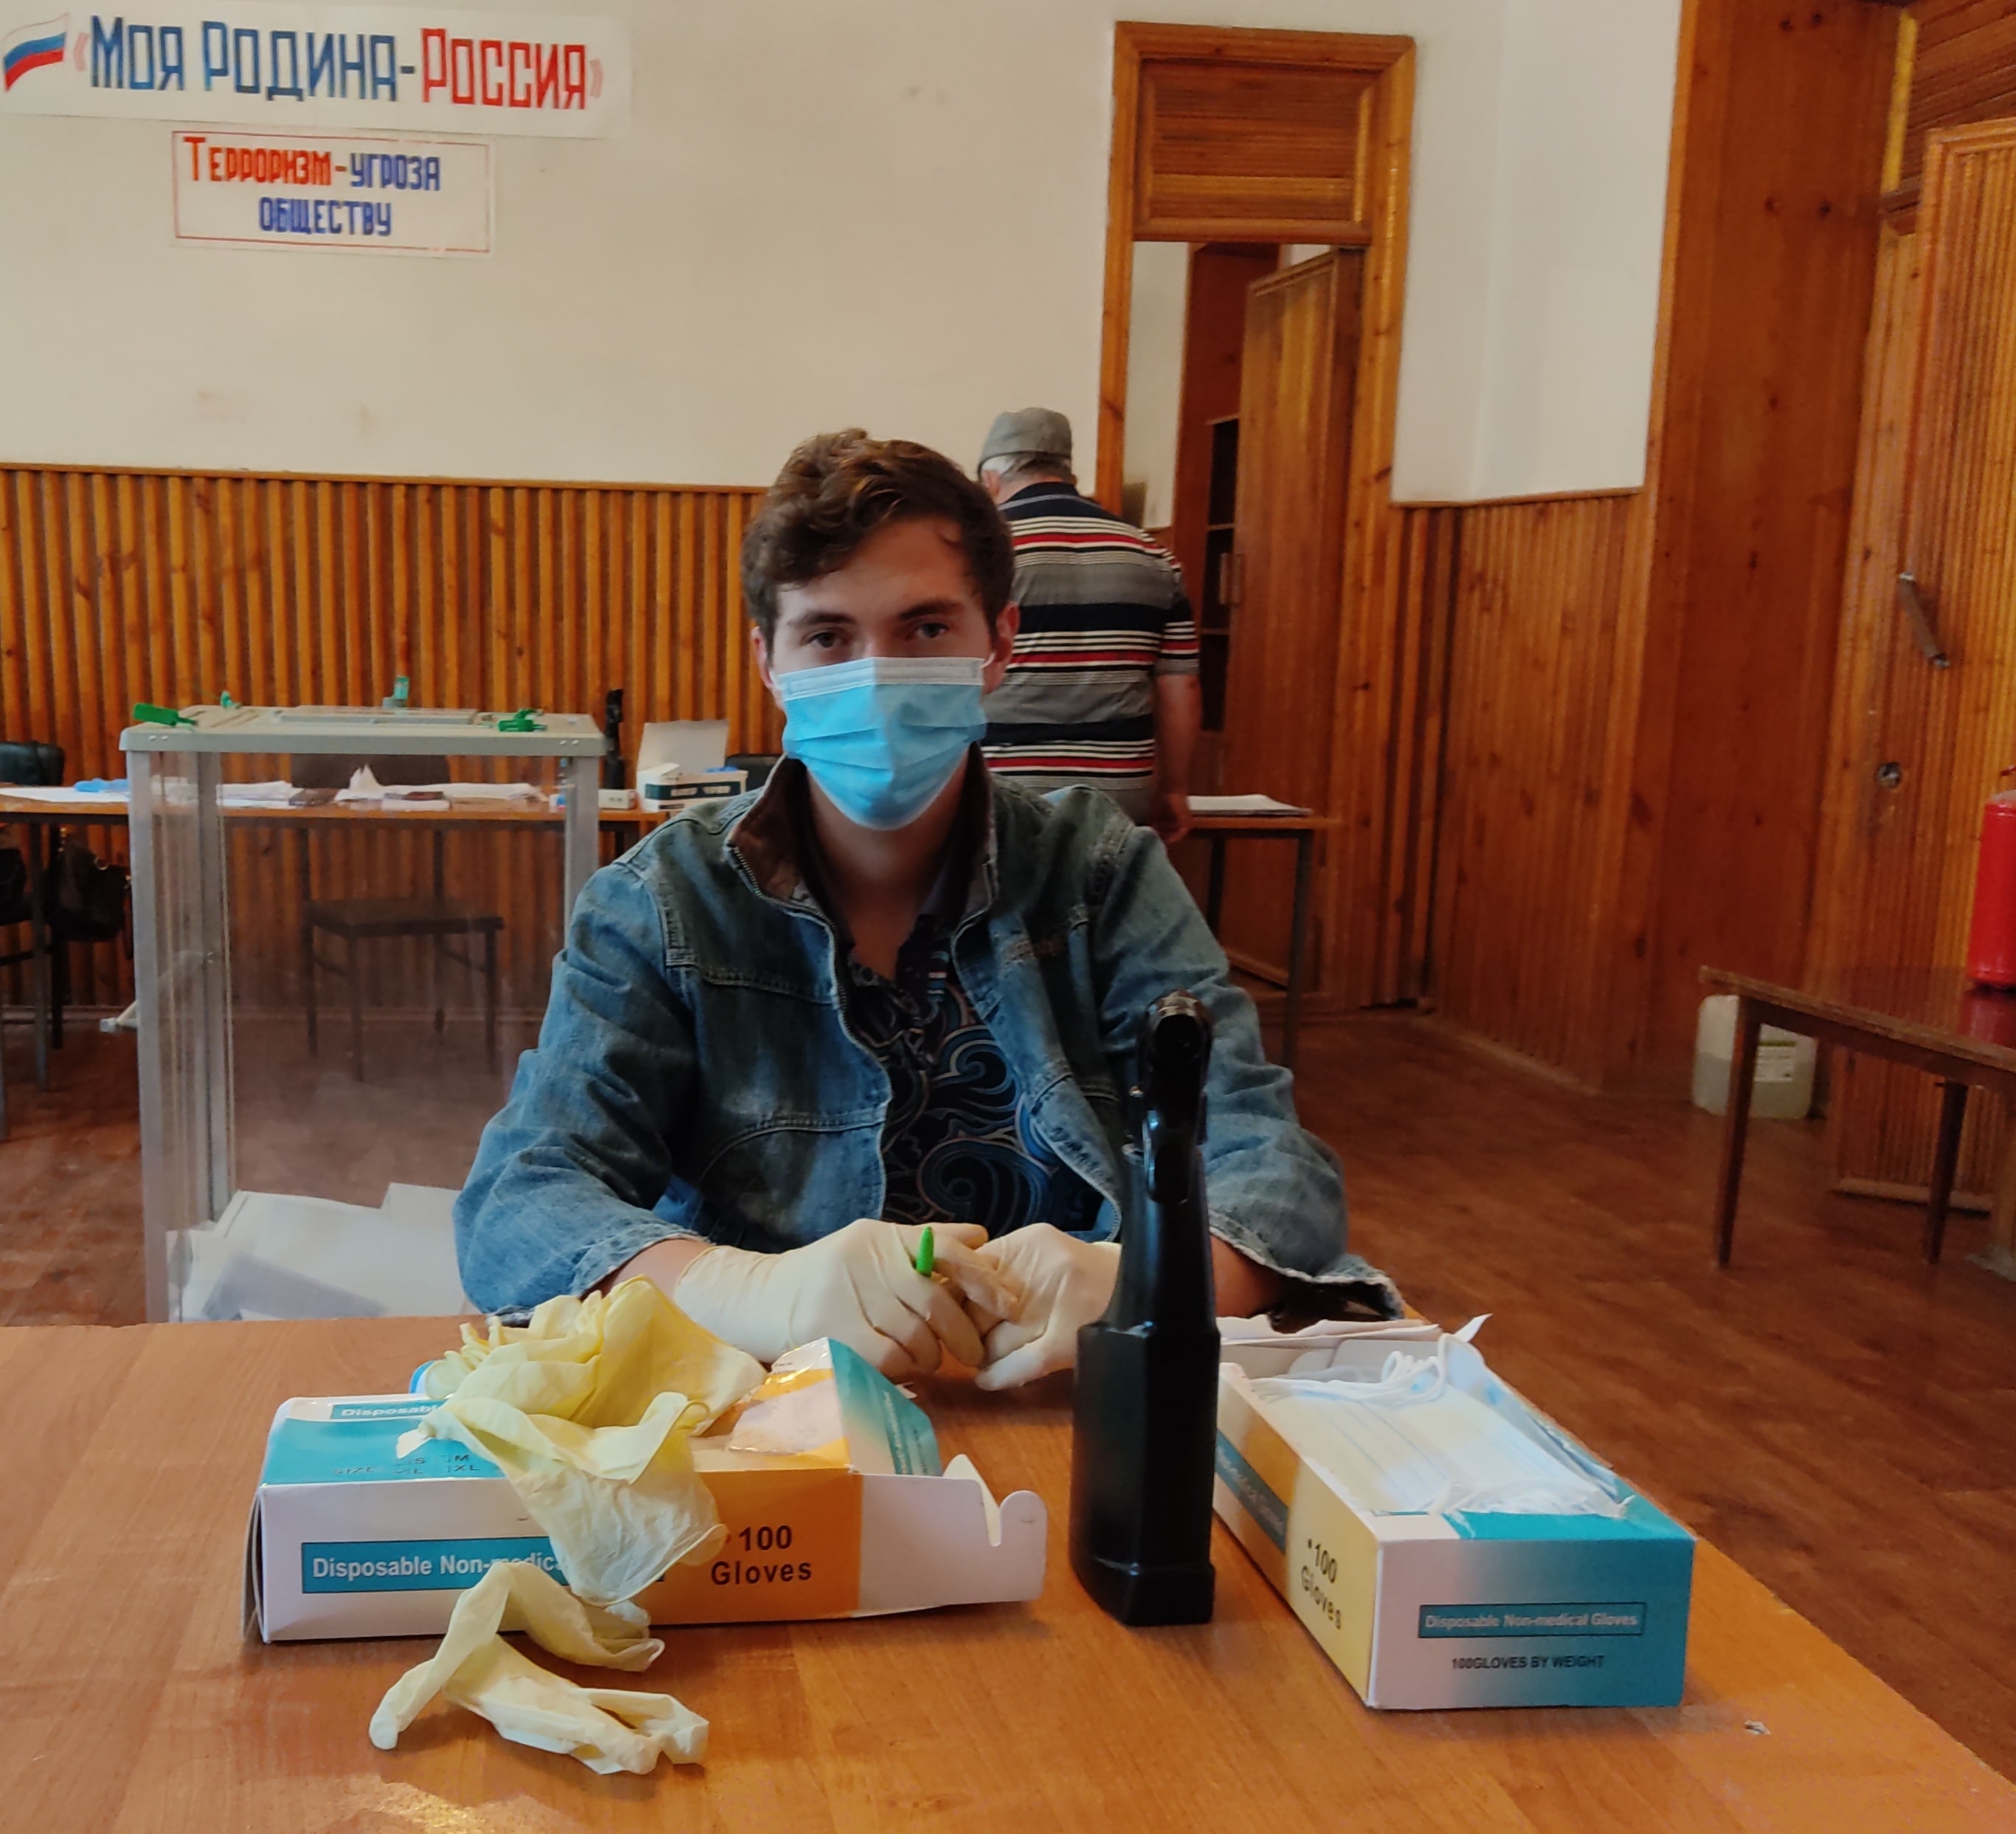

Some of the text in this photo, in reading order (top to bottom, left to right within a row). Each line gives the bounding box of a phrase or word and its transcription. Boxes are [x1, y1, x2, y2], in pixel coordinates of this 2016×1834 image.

[340, 1404, 438, 1417] Disposabl
[313, 1556, 432, 1582] Disposable
[711, 1560, 811, 1585] Gloves
[1425, 1614, 1500, 1630] Disposable
[1590, 1612, 1637, 1626] Gloves
[1530, 1655, 1549, 1668] BY
[1552, 1655, 1606, 1668] WEIGHT
